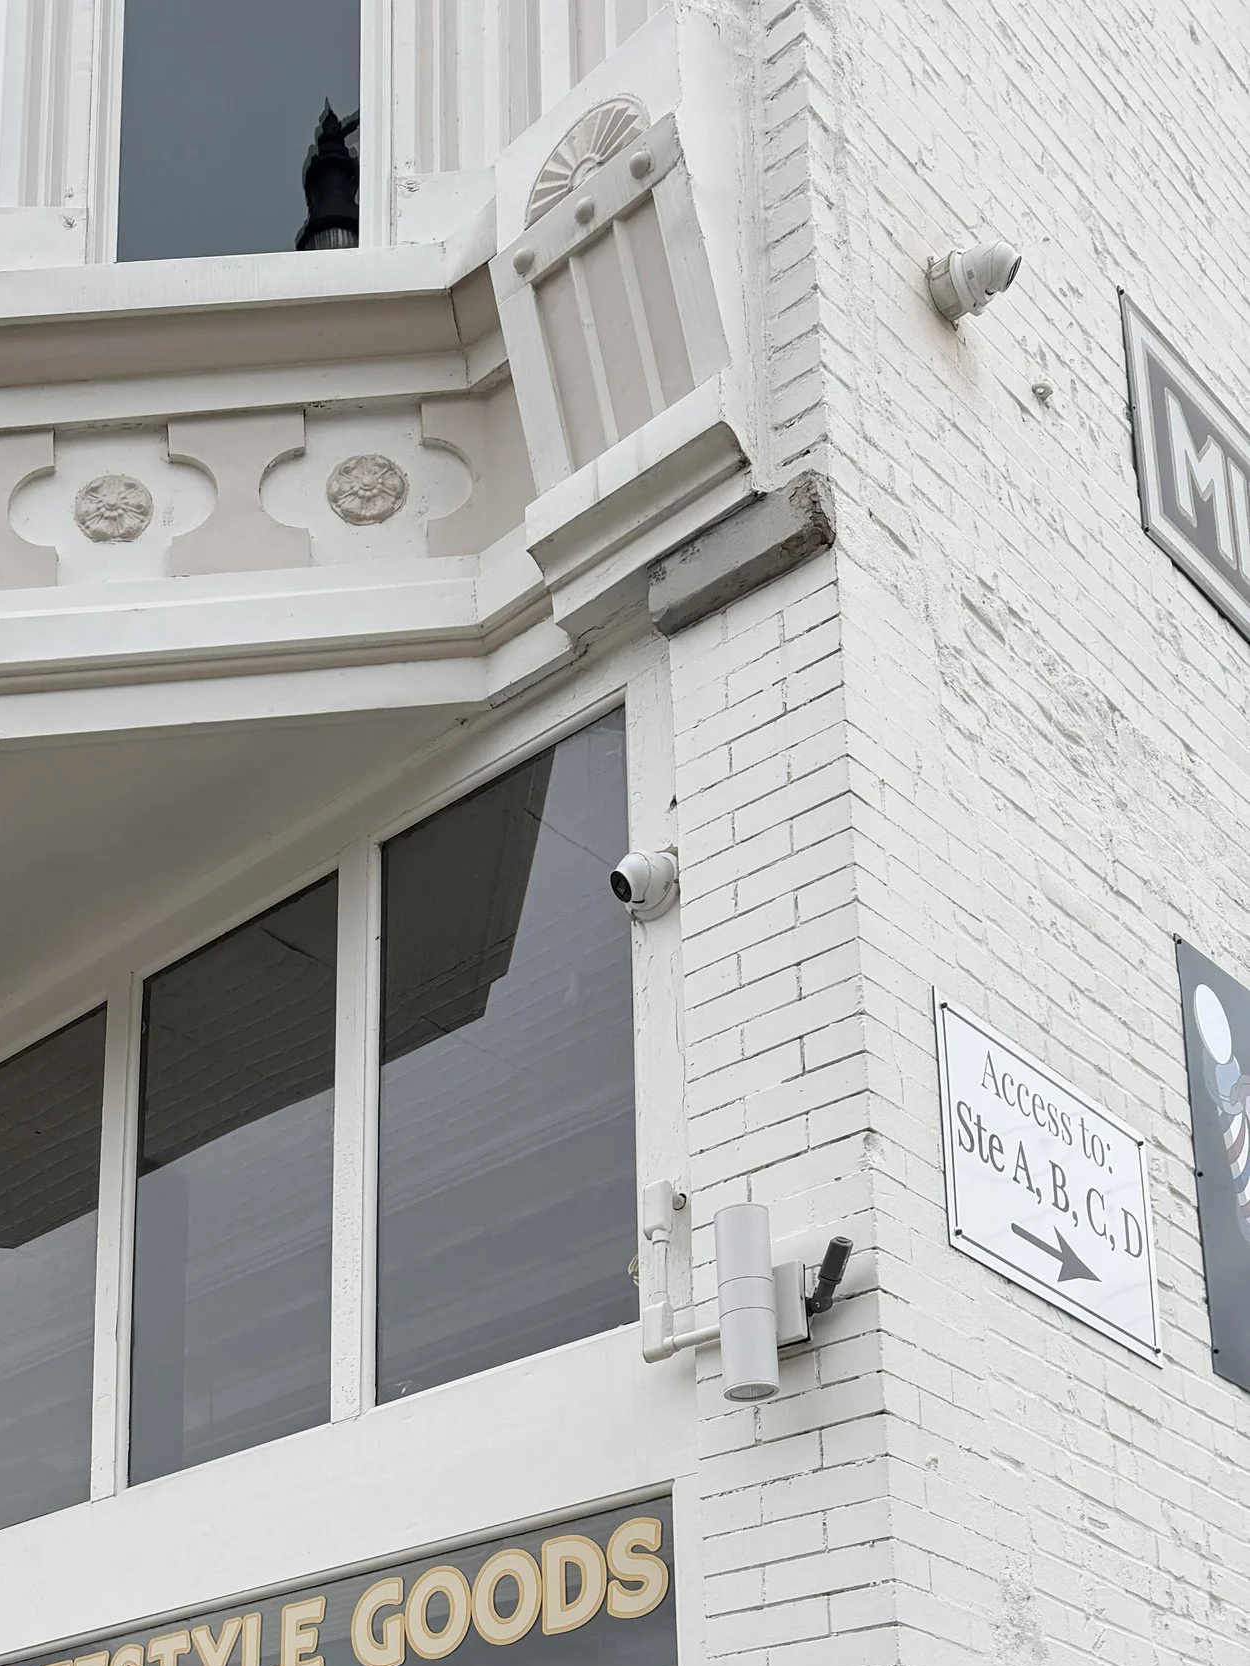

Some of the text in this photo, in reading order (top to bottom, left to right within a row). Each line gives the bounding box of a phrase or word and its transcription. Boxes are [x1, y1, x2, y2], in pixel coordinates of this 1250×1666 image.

[955, 1100, 1006, 1173] Ste
[1121, 1206, 1144, 1259] D
[979, 1049, 1114, 1175] Access to:
